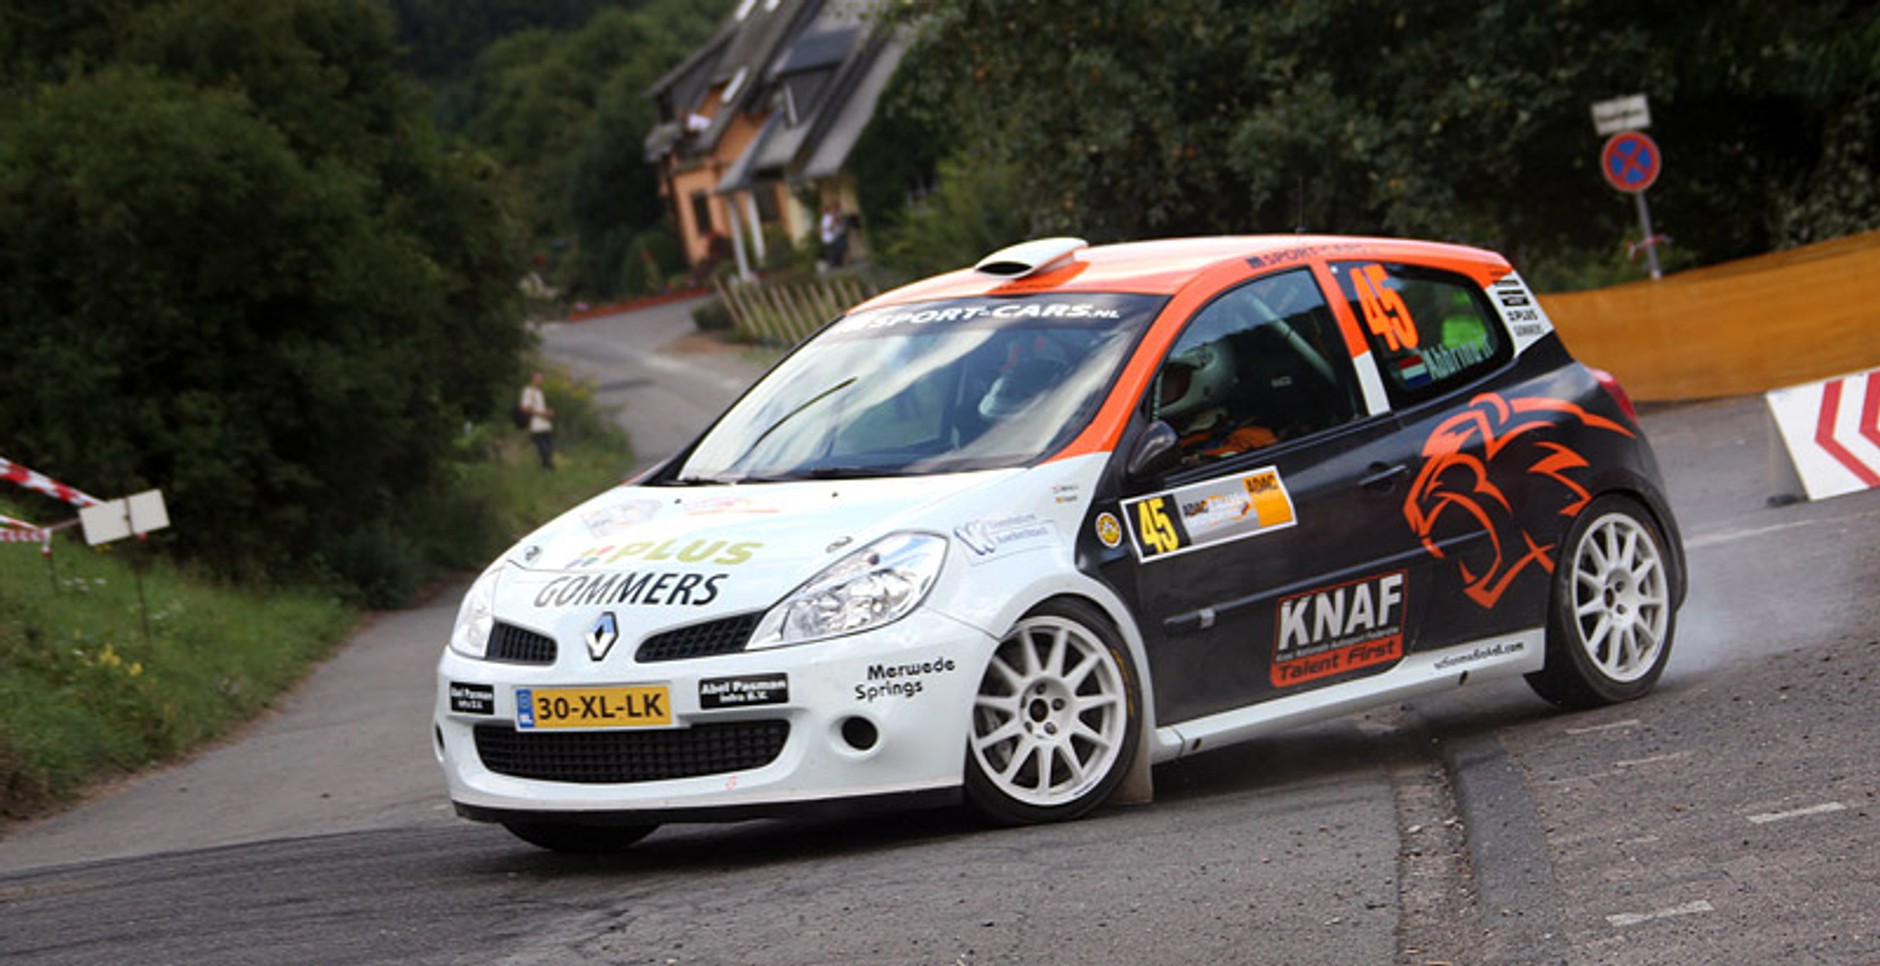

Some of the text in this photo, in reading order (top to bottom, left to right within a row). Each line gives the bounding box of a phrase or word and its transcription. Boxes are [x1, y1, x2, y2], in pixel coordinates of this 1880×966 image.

[1348, 263, 1419, 352] 45
[1137, 497, 1179, 553] 45
[605, 539, 766, 566] PLUS
[533, 571, 729, 607] GOMMERS
[1278, 573, 1403, 651] KNAF
[867, 656, 956, 681] Merwede
[1279, 653, 1340, 681] Talent
[1345, 640, 1396, 665] First
[538, 692, 664, 720] 30-XL-LK
[854, 680, 924, 703] Springs
